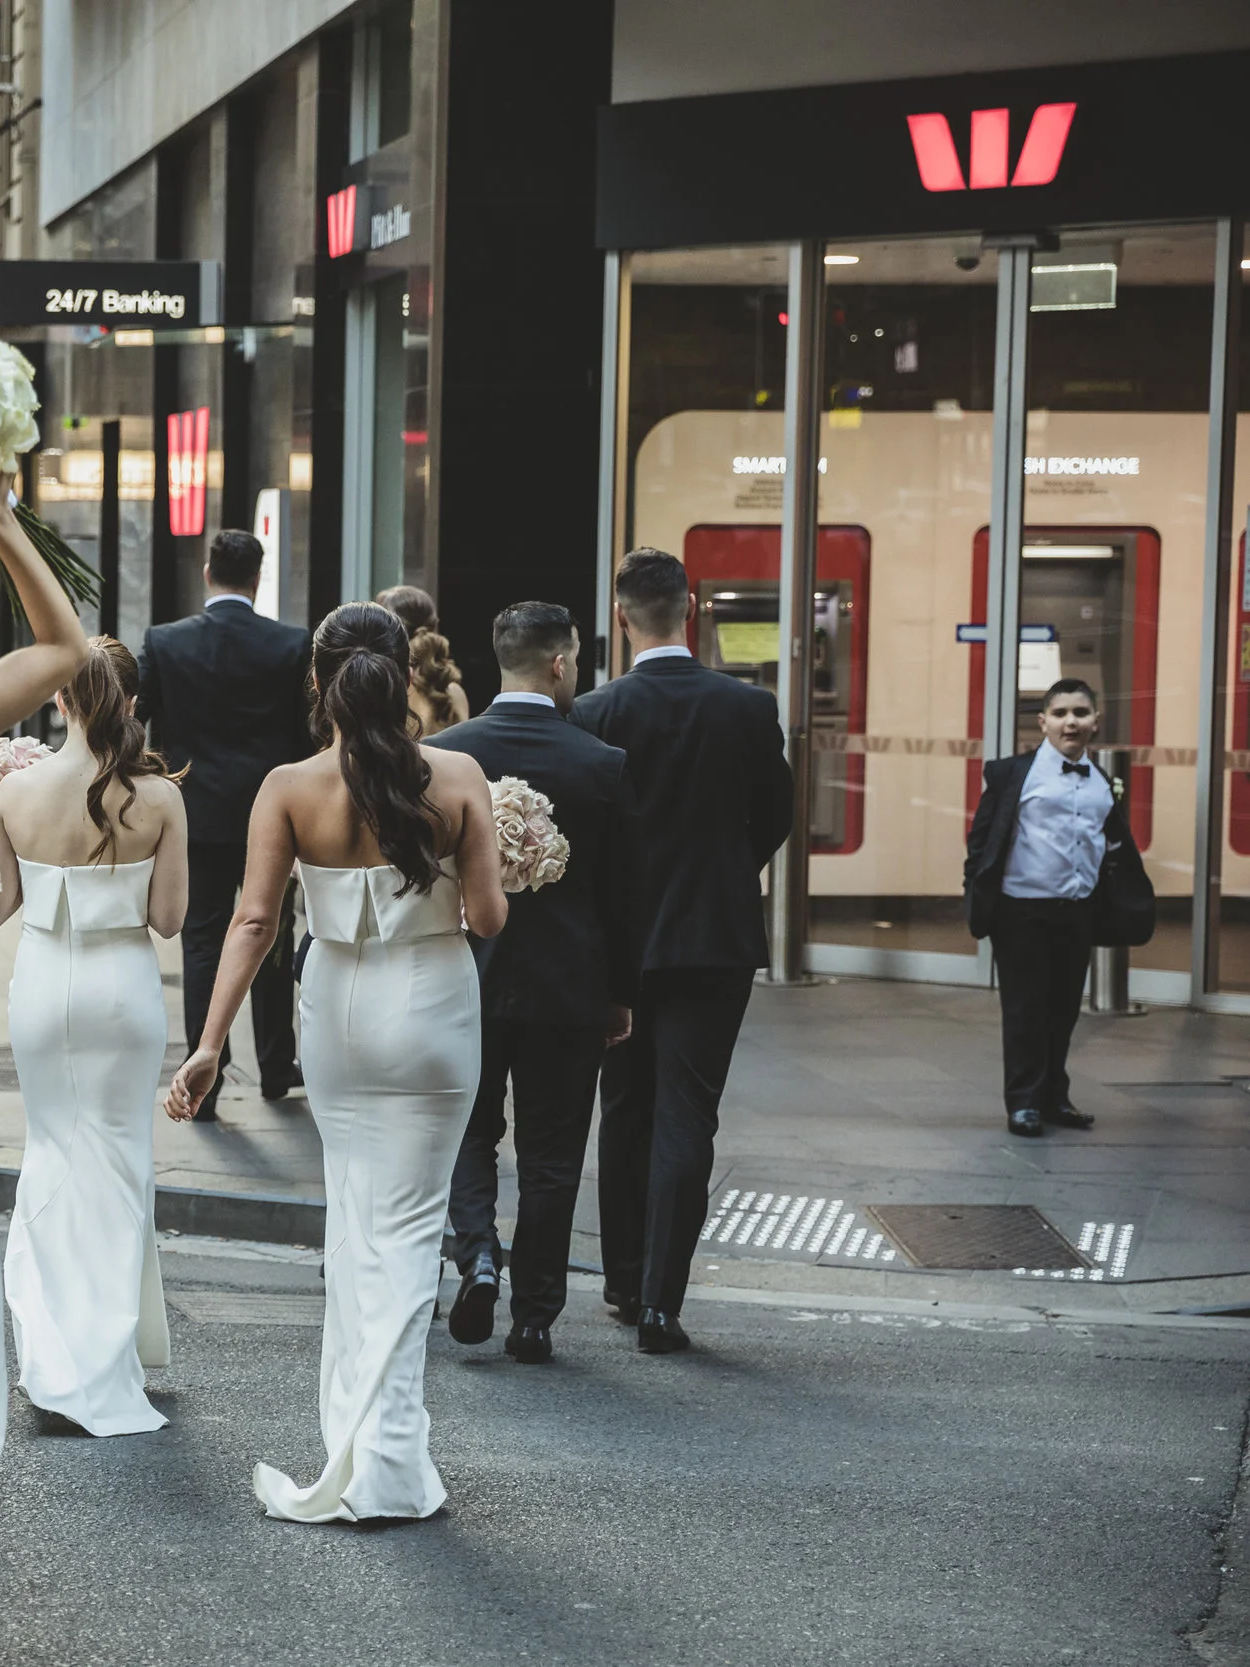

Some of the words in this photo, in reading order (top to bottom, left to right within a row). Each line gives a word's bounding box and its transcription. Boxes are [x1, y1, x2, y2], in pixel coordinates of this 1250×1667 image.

[45, 288, 99, 313] 24/7
[102, 289, 185, 319] Banking
[732, 456, 787, 474] SMART
[1023, 456, 1046, 475] SH
[1047, 456, 1140, 475] EXCHANGE
